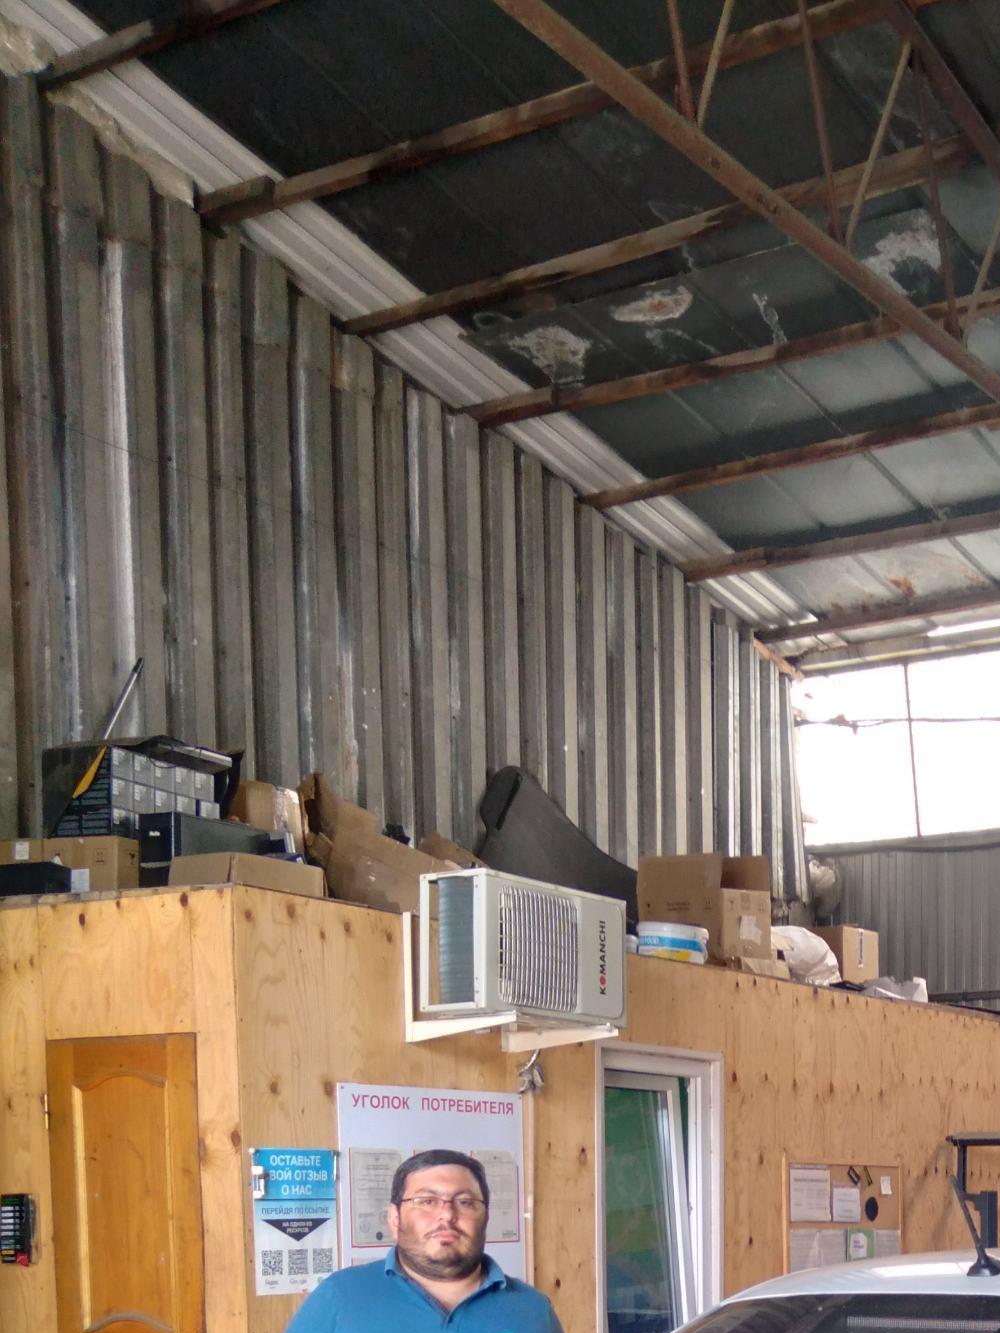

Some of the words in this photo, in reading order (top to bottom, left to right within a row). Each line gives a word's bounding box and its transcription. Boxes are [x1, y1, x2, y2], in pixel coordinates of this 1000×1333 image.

[598, 920, 607, 995] KOMANCHI
[351, 1094, 411, 1110] УГОЛОК
[421, 1097, 514, 1116] ПОТРЕБИТЕЛЯ
[269, 1154, 321, 1167] ОСТАВЬТЕ
[294, 1169, 328, 1181] ОТЗЫВ
[291, 1184, 312, 1196] НАС
